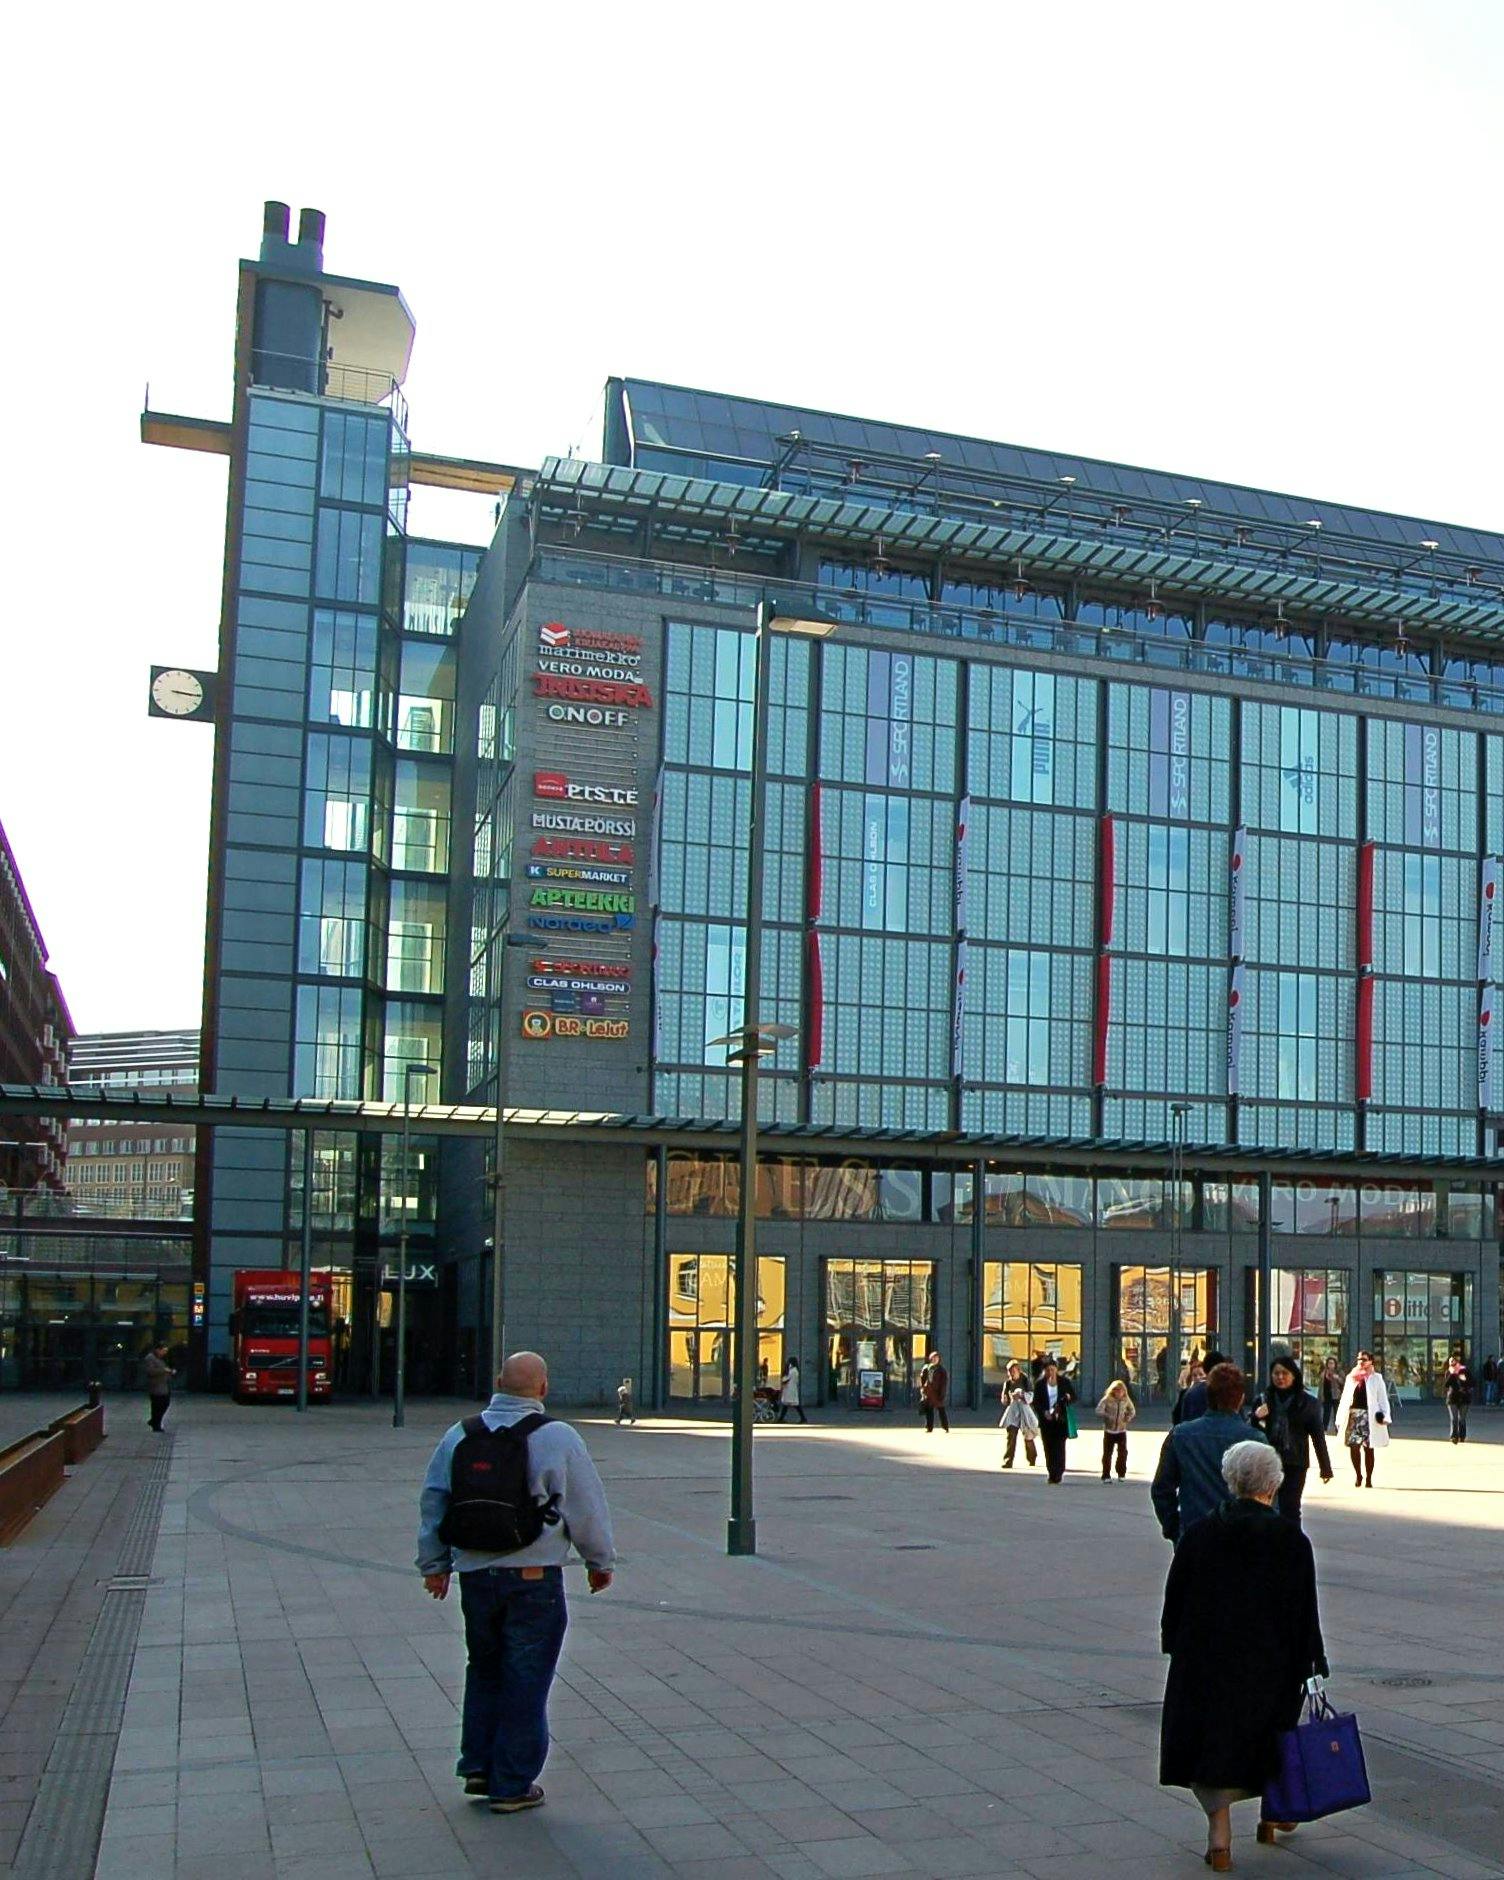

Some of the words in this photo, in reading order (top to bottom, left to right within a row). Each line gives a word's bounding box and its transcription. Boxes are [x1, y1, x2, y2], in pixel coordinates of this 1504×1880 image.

[538, 645, 639, 667] marimekko
[538, 660, 582, 675] VERO
[586, 662, 634, 681] MODA
[548, 704, 630, 727] ONOFF
[1301, 755, 1314, 804] adidas
[567, 783, 639, 805] PISTE
[546, 868, 628, 884] SUPERMARKET
[531, 887, 637, 914] APTEEKKI
[533, 977, 569, 989] CLAS
[571, 980, 625, 992] OHLSON
[384, 1263, 435, 1280] LUX
